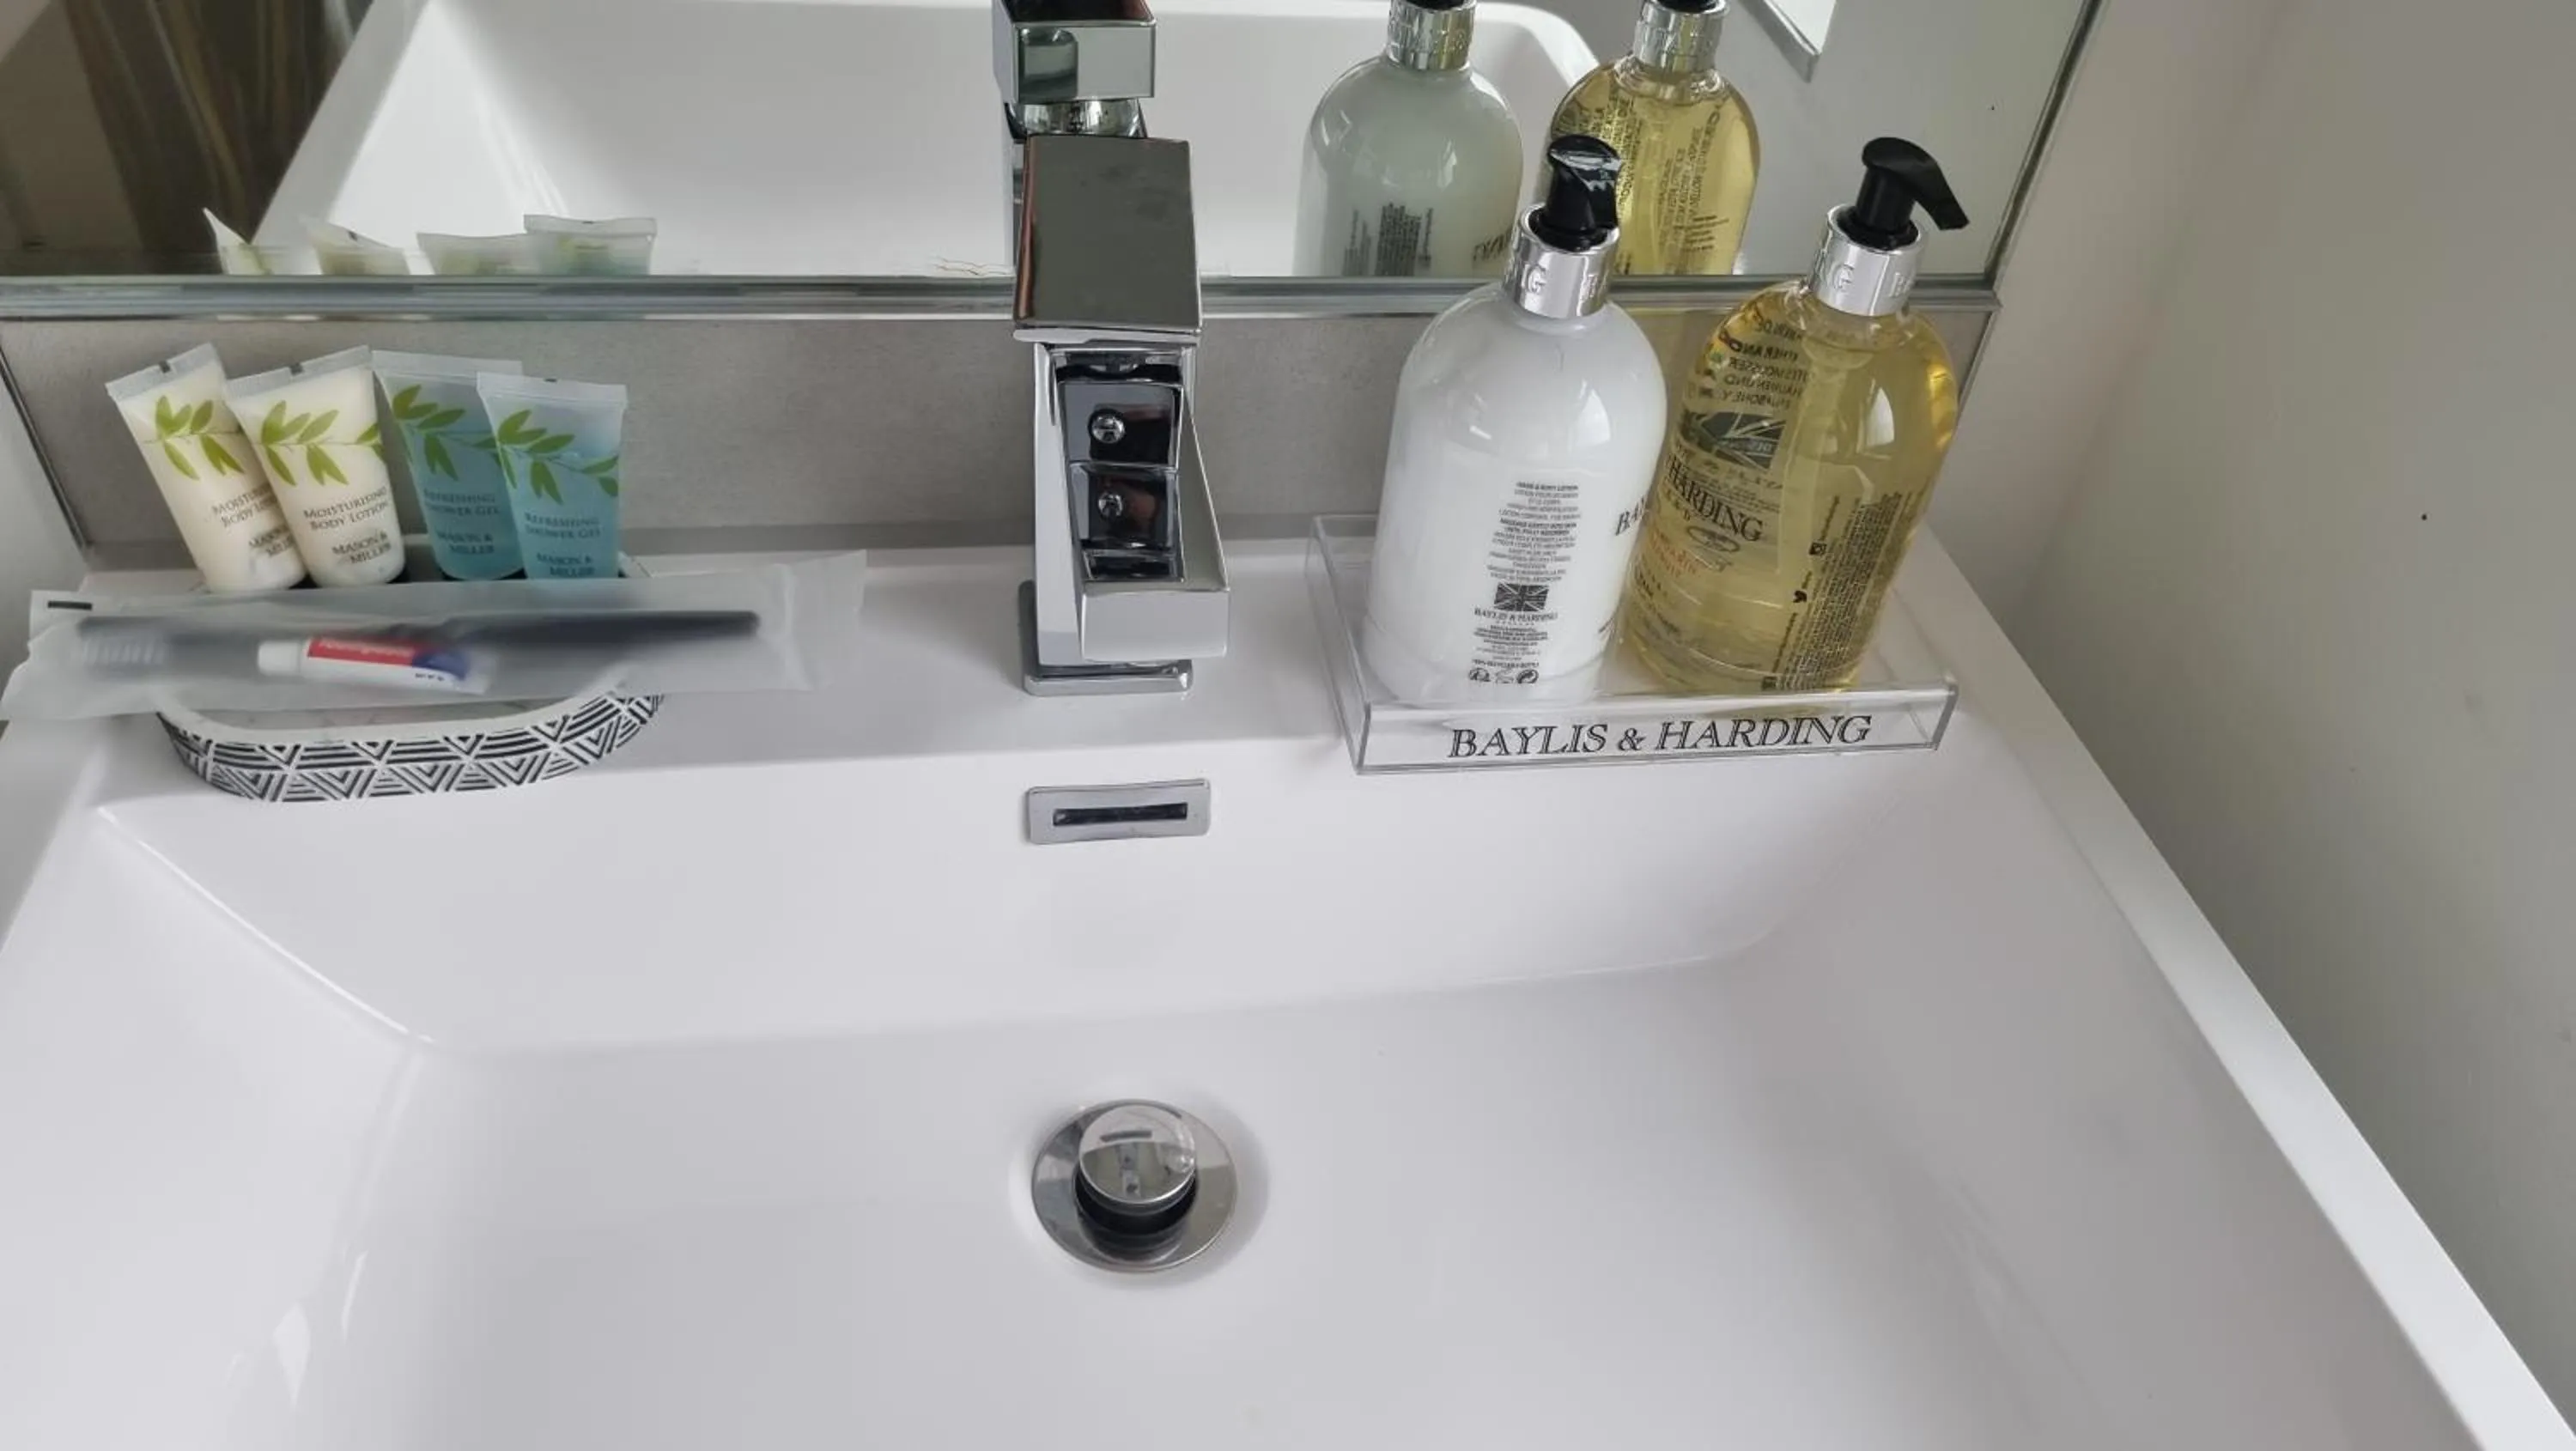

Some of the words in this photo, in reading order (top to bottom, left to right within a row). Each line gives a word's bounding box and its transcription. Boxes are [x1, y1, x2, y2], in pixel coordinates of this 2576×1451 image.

[1447, 724, 1608, 758] BAYLIS
[1617, 727, 1646, 752] &
[1655, 714, 1873, 750] HARDING
